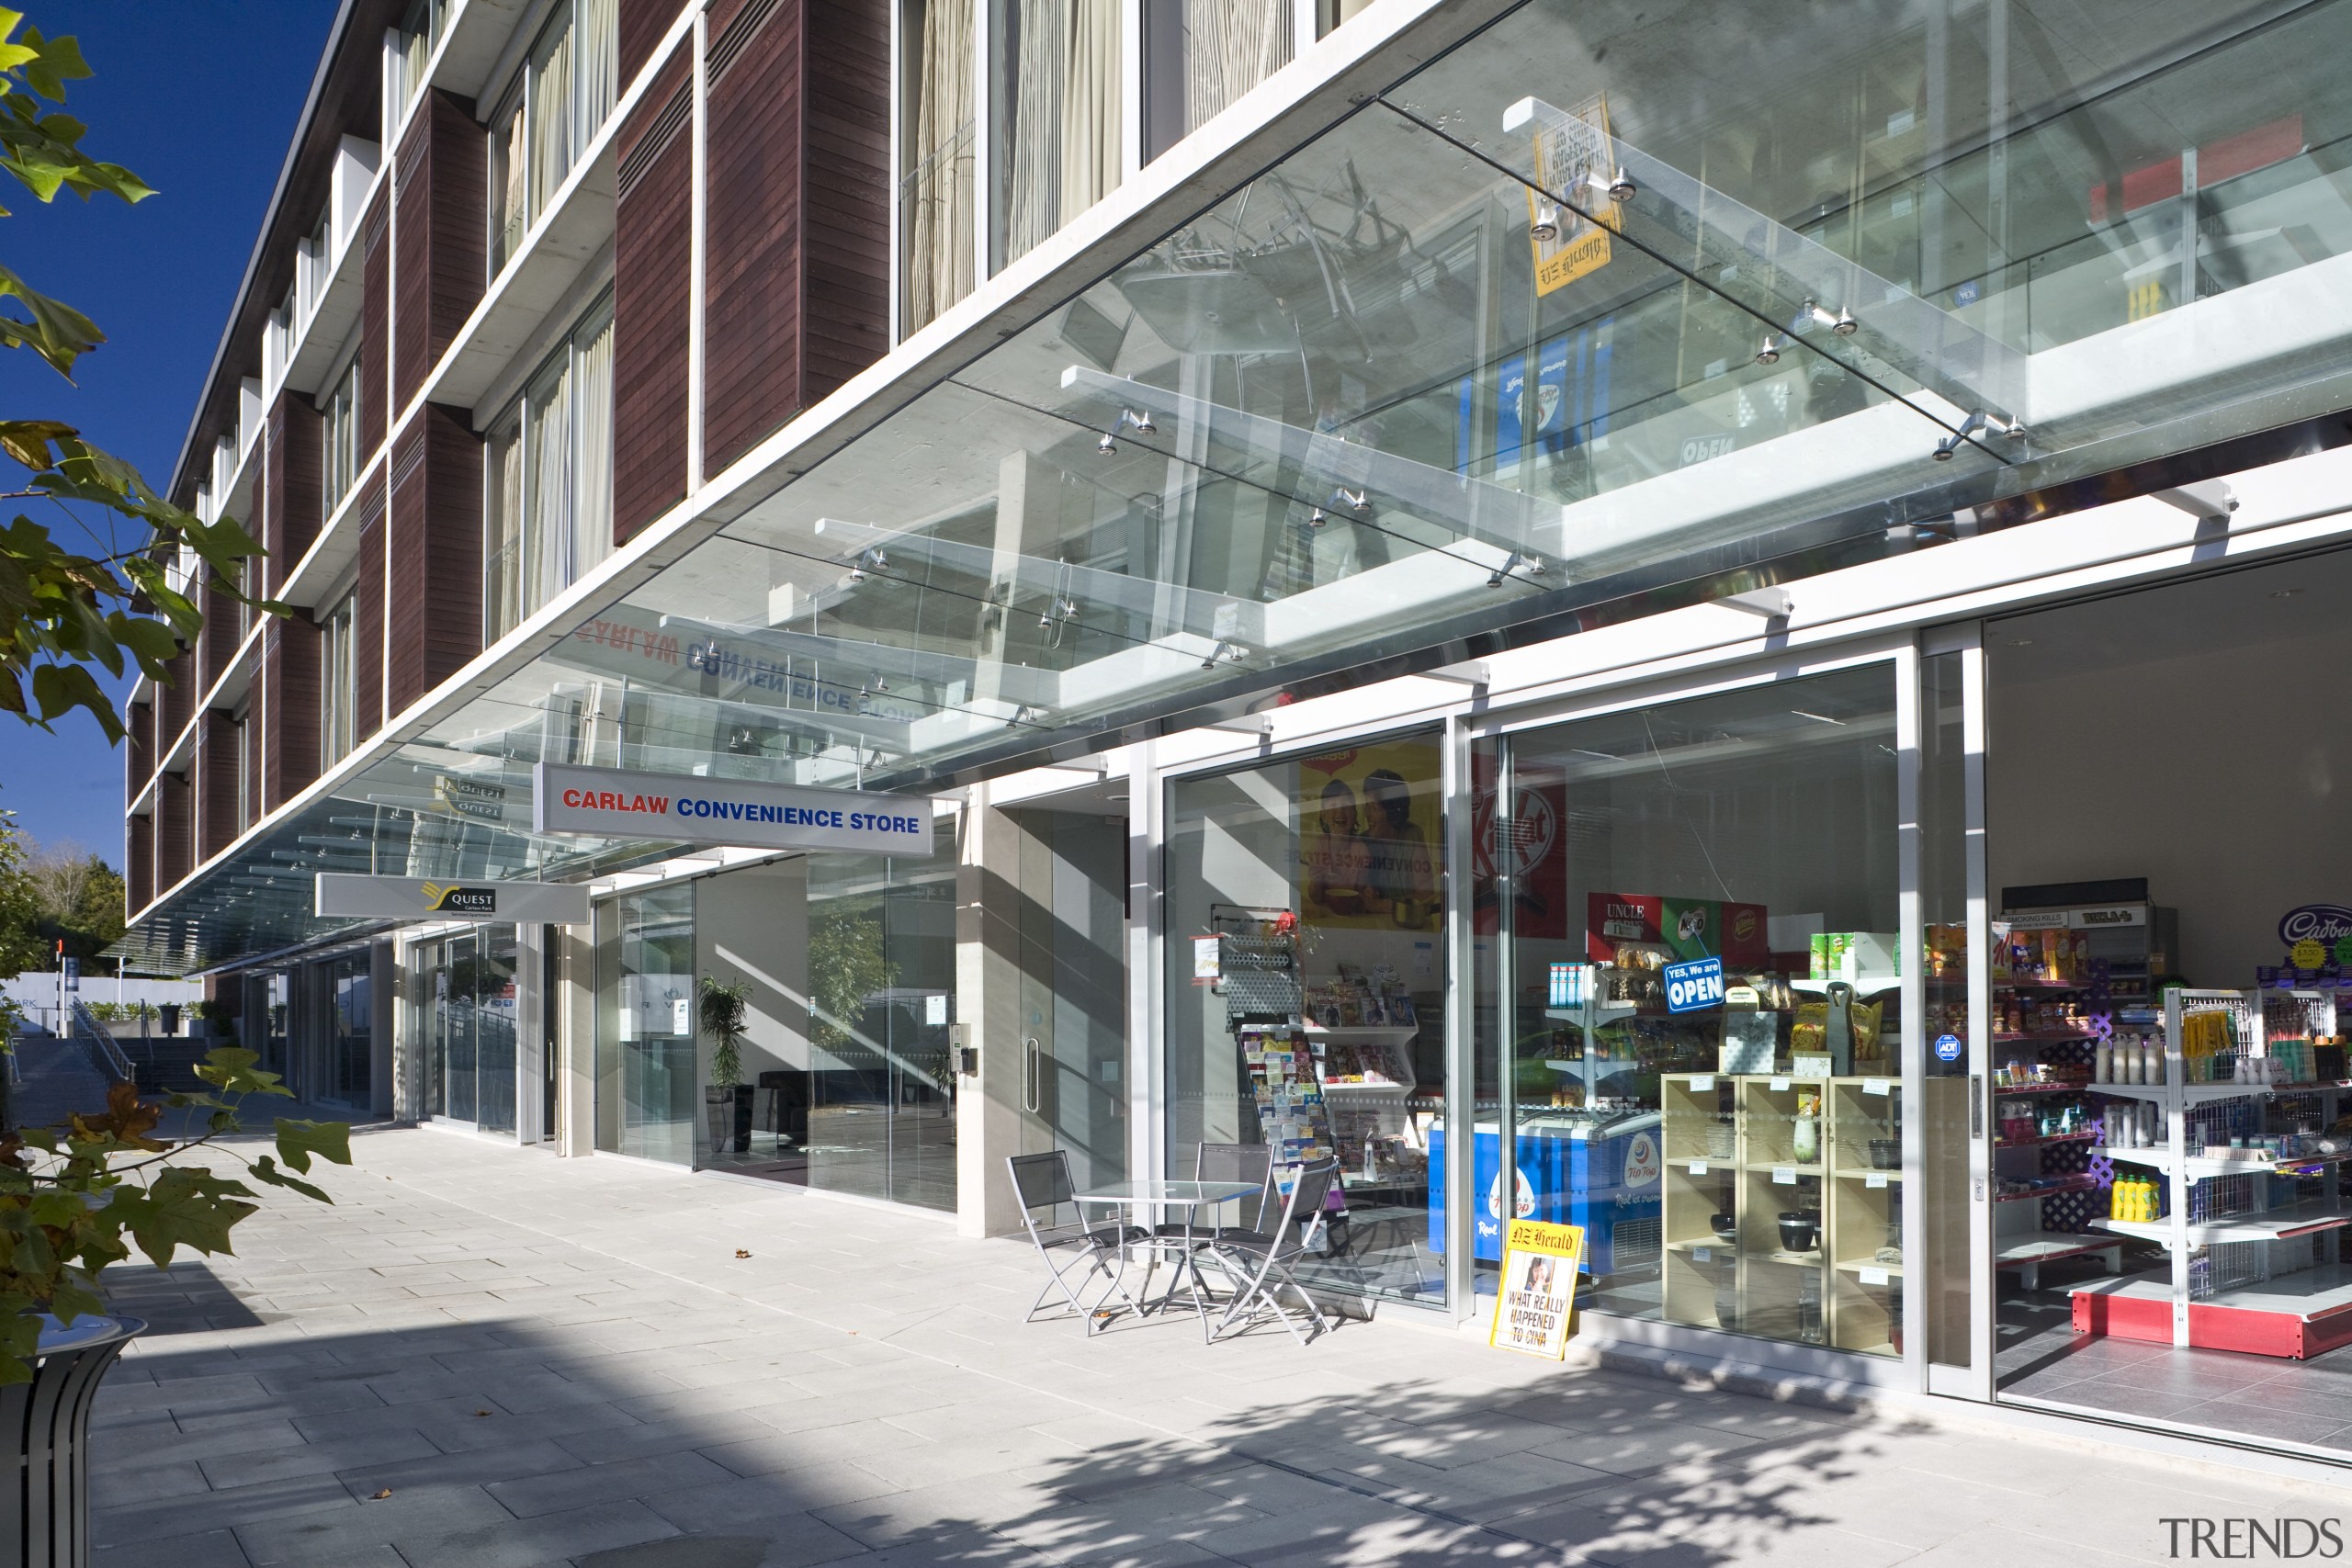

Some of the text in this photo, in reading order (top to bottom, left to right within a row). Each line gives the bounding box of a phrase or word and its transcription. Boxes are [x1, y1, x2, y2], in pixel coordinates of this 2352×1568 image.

[563, 788, 919, 833] CARLAW CONVENIENCE STORE
[452, 895, 492, 905] QUEST
[1607, 904, 1645, 919] UNCLE
[2007, 914, 2041, 923] SMOKING
[1668, 964, 1719, 978] YES, We are
[1670, 976, 1723, 1006] OPEN
[1939, 1043, 1956, 1053] ADT
[1628, 1166, 1657, 1179] Tip Top
[1615, 1193, 1632, 1209] Real
[1477, 1220, 1498, 1238] Real
[1512, 1226, 1573, 1250] NZ Herald
[1509, 1290, 1566, 1314] WHAT REALLY
[1510, 1309, 1555, 1330] HAPPENED
[1512, 1326, 1522, 1343] TO
